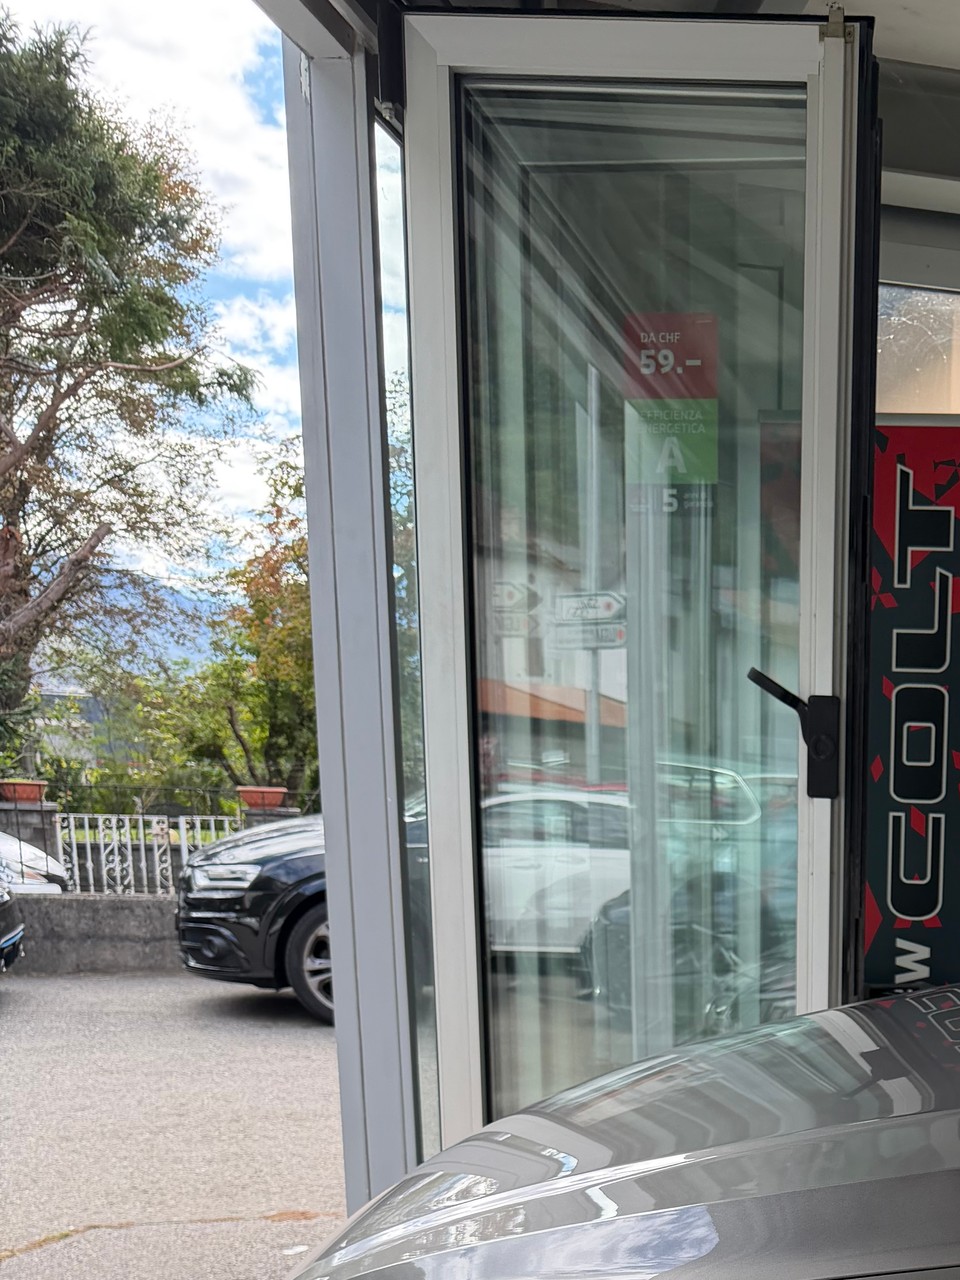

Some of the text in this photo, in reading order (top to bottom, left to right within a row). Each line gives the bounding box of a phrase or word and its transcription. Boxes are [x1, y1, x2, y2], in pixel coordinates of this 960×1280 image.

[640, 332, 681, 343] DA CHF
[656, 436, 687, 473] A
[662, 488, 679, 513] 5
[886, 463, 955, 921] COLT
